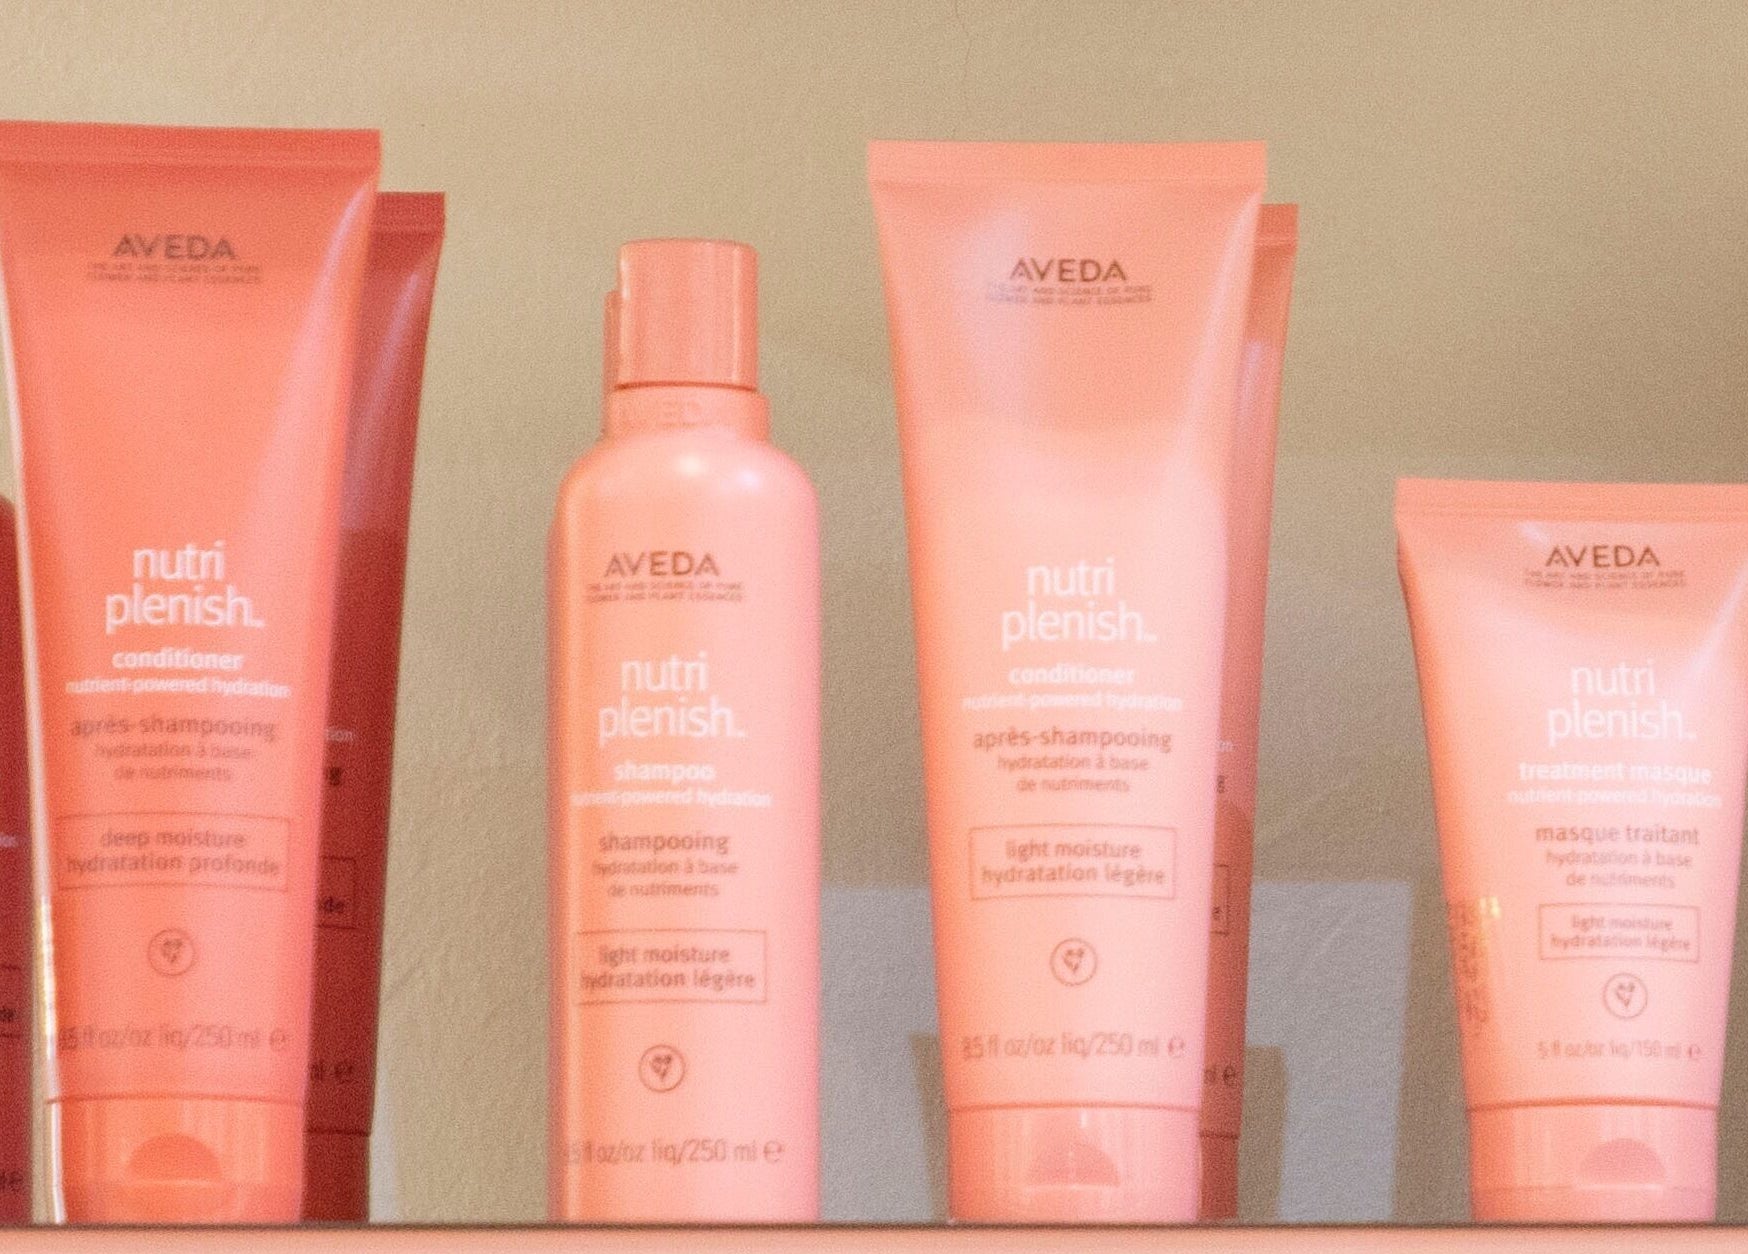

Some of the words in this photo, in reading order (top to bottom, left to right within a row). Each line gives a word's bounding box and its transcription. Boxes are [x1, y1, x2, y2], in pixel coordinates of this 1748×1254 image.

[113, 234, 238, 260] AVEDA
[1009, 257, 1128, 282] AVEDA
[132, 541, 226, 581] nutri
[604, 551, 719, 577] AVEDA
[1546, 546, 1660, 568] AVEDA
[1026, 557, 1114, 597] nutri
[113, 648, 244, 671] conditioner
[621, 651, 709, 691] nutri
[1008, 665, 1135, 685] conditioner
[1571, 660, 1655, 697] nutri
[973, 727, 1172, 753] après-shampooing
[613, 760, 715, 784] shampoo
[1519, 762, 1623, 780] treatment
[1629, 764, 1711, 784] masque
[599, 832, 729, 854] shampooing
[1536, 827, 1620, 845] masque
[1625, 825, 1701, 845] traitant
[1006, 840, 1049, 859] light
[1055, 840, 1141, 858] moisture
[981, 864, 1097, 885] hydratation
[1105, 865, 1165, 885] légère
